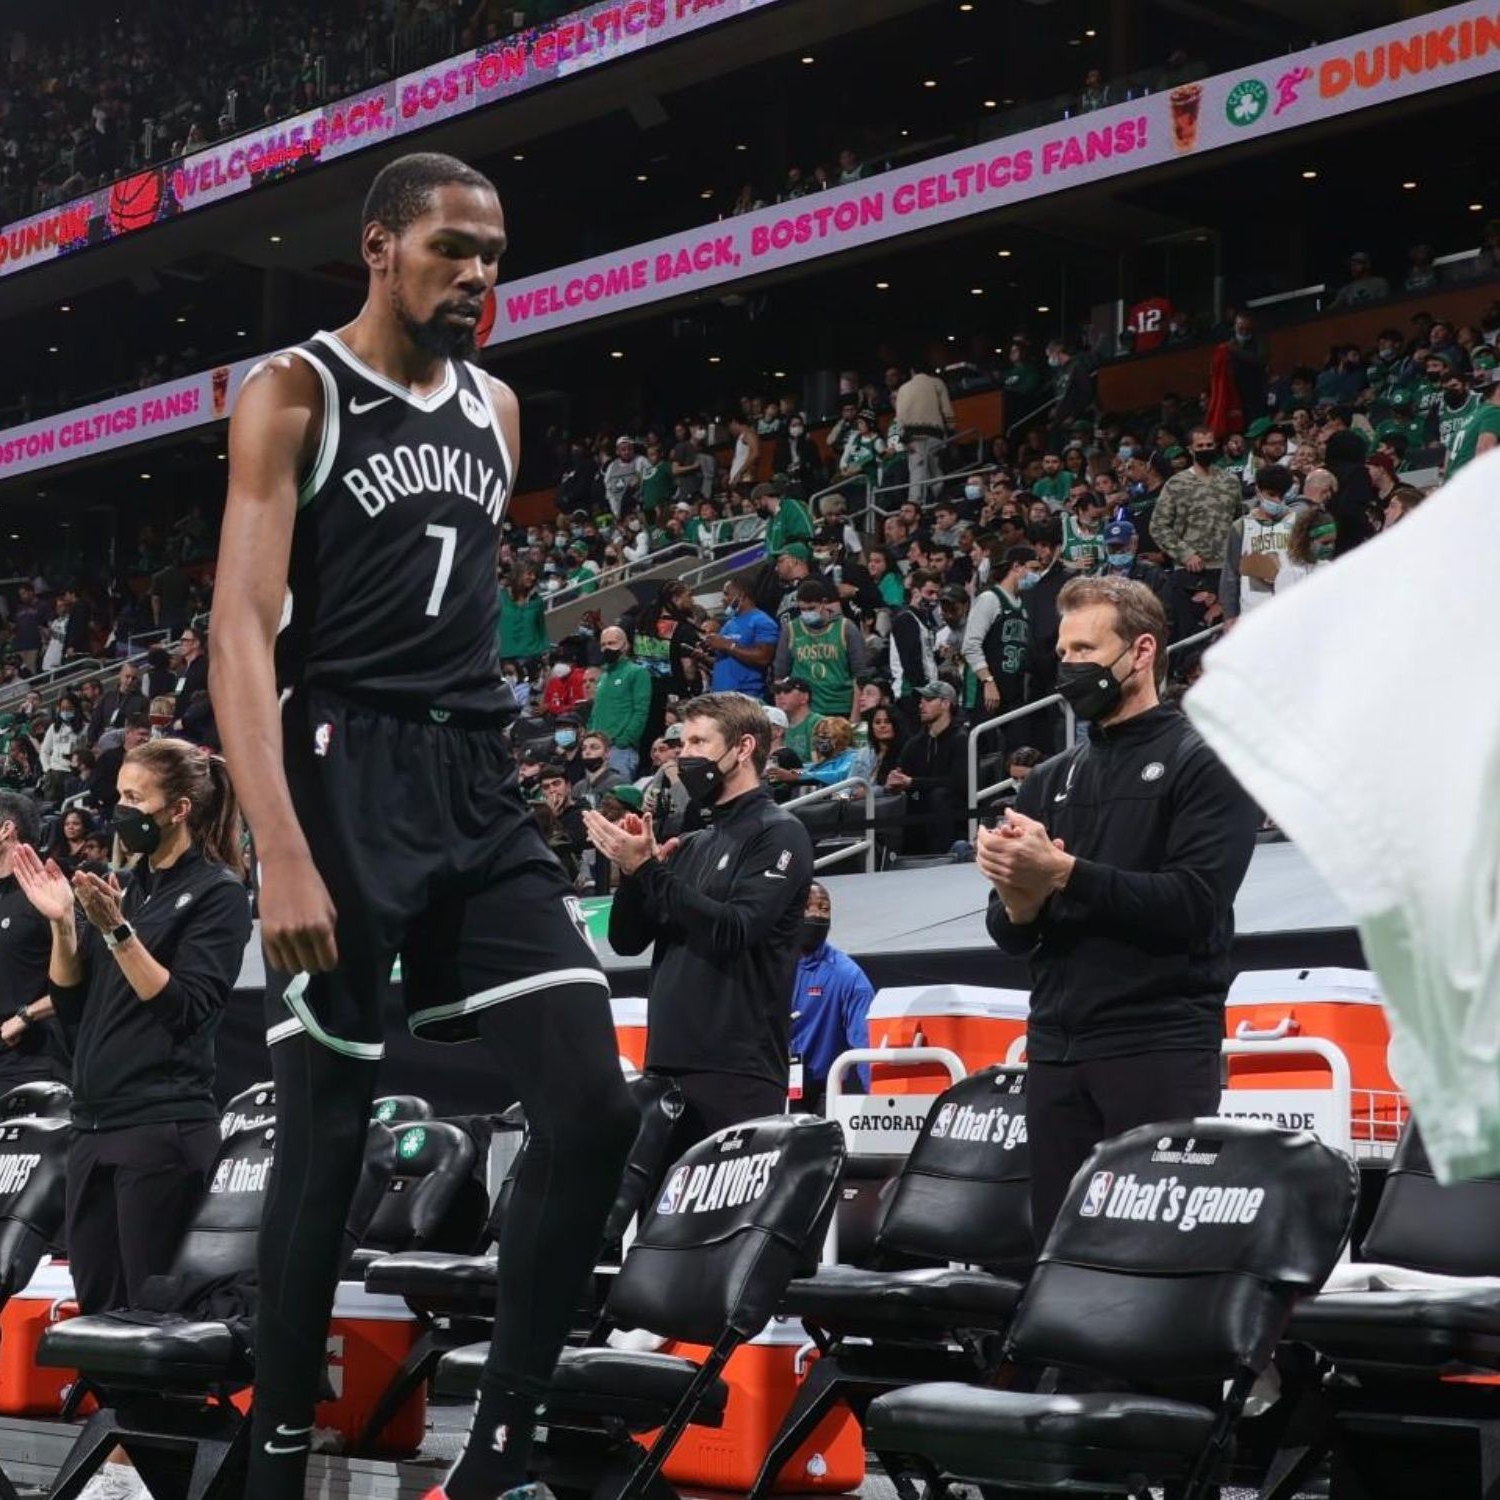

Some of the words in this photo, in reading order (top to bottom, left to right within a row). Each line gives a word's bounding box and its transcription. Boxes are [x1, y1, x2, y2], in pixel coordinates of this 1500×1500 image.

[401, 44, 526, 118] BOSTON
[506, 259, 649, 323] WELCOME
[654, 235, 742, 284] BACK,
[750, 192, 883, 258] BOSTON
[893, 150, 1034, 215] CELTICS
[1042, 115, 1148, 175] FANS!
[1137, 309, 1161, 333] 12
[60, 408, 136, 448] CELTICS
[141, 388, 200, 426] FANS!
[343, 443, 506, 526] BROOKLYN
[425, 523, 457, 617] 7
[849, 1115, 926, 1132] GATORAD
[950, 1104, 1010, 1143] that's
[1185, 1138, 1196, 1153] 9
[678, 1150, 782, 1214] PLAYOFFS
[1105, 1175, 1183, 1224] that's
[1178, 1186, 1265, 1232] game
